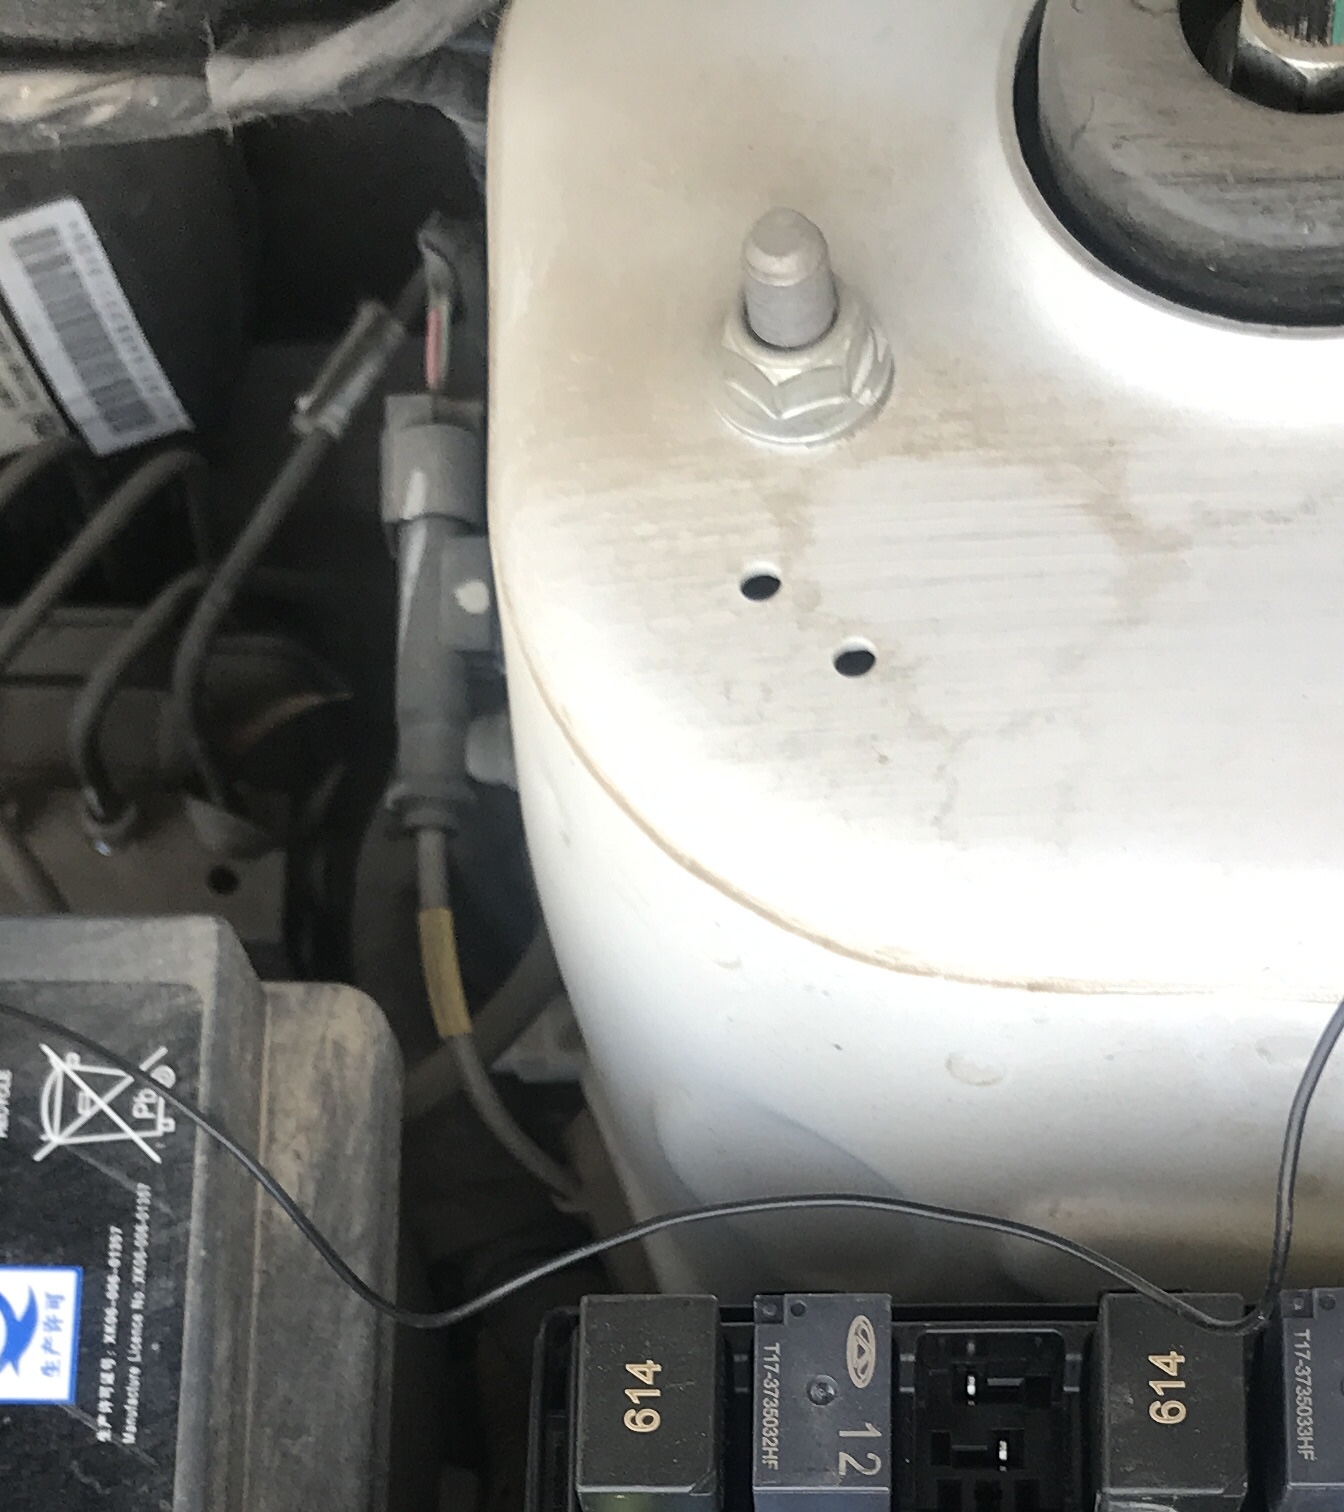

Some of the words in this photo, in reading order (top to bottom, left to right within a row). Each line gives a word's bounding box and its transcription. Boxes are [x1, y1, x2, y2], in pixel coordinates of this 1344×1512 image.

[132, 1089, 157, 1119] Pb
[623, 1359, 662, 1433] 614
[761, 1342, 781, 1470] T17-3735032HF
[1148, 1351, 1186, 1424] 614
[839, 1422, 882, 1476] 12
